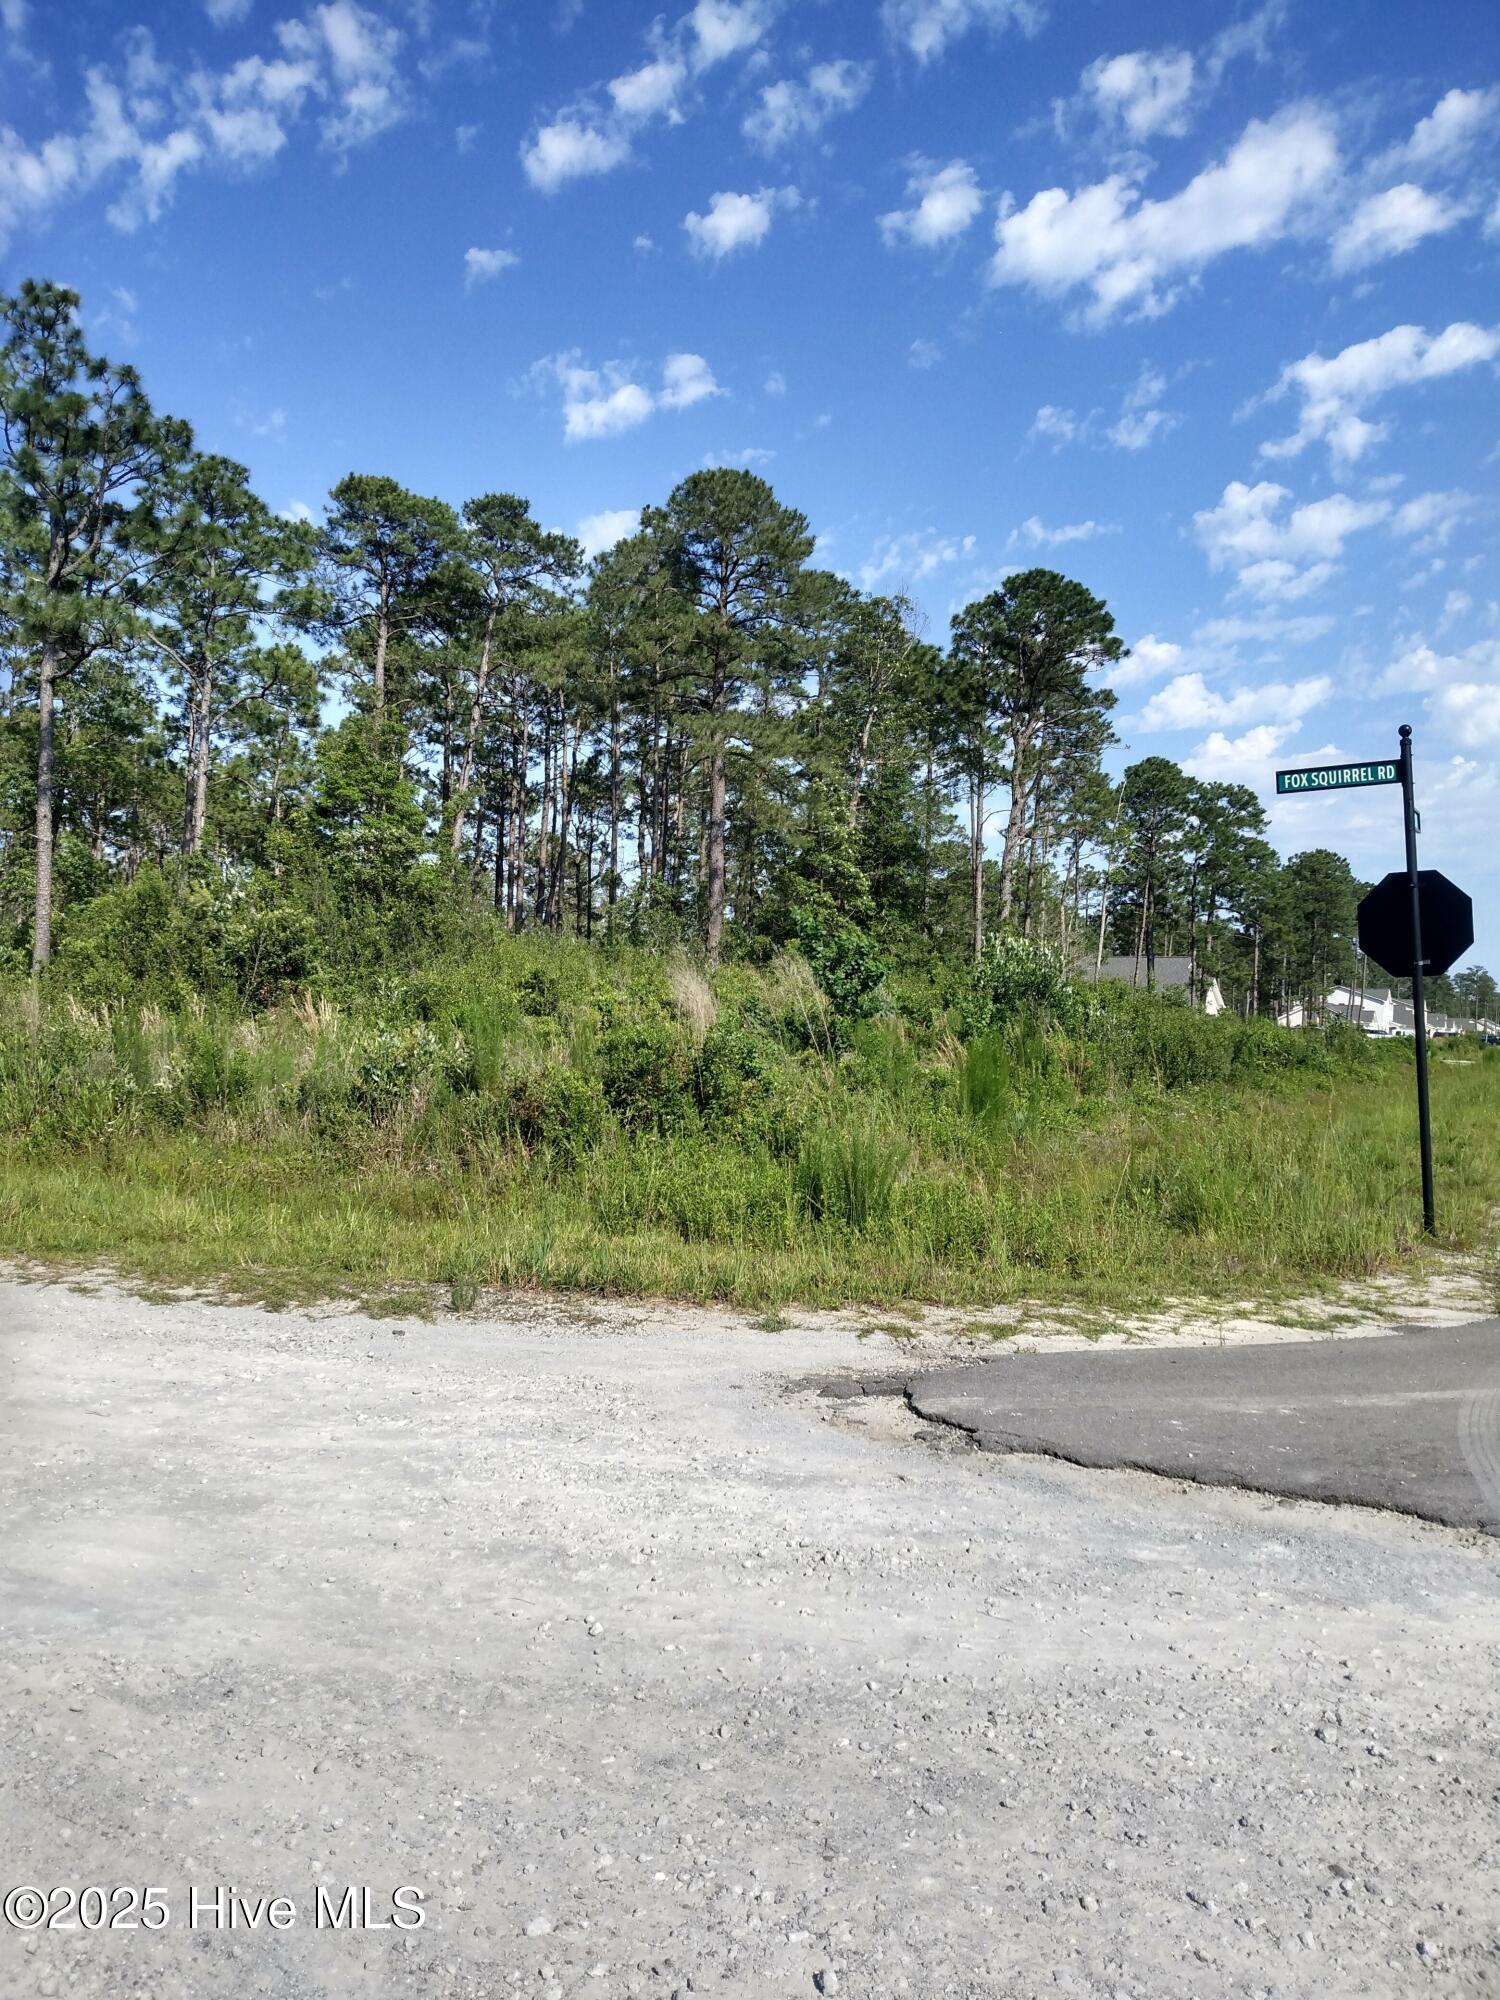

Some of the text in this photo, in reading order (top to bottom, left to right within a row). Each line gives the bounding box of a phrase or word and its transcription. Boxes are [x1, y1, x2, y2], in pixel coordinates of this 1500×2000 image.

[1284, 765, 1395, 789] FOX SQUIRREL RD
